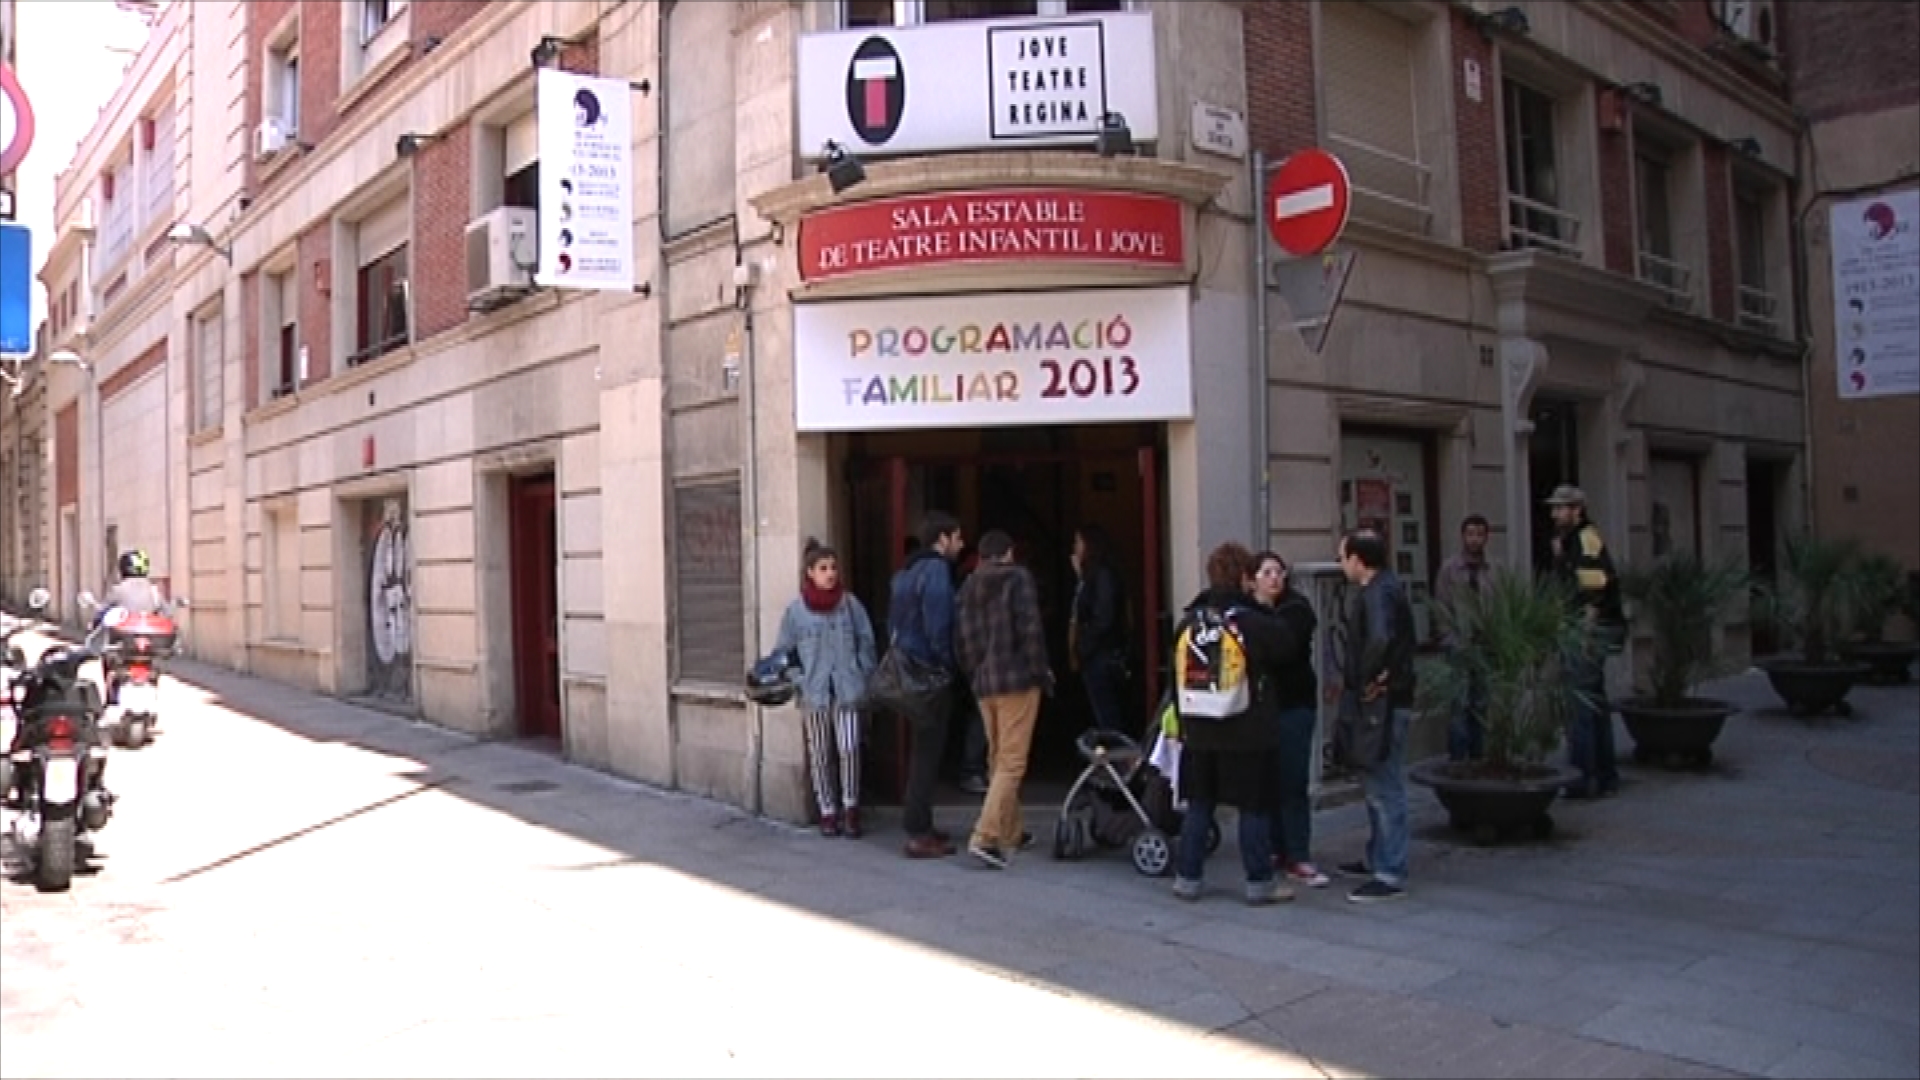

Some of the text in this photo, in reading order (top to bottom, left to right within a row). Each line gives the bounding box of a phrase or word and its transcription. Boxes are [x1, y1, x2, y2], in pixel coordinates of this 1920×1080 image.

[1018, 36, 1067, 60] JOVE
[1008, 67, 1087, 92] TEATRE
[1009, 100, 1088, 125] REGINA
[892, 200, 1085, 230] SALA ESTABLE
[819, 228, 1165, 270] DE TEATRE INFANTIL I JOVE
[848, 314, 1132, 358] PROGRAMACIÓ
[843, 355, 1140, 405] FAMILIAR 2013
